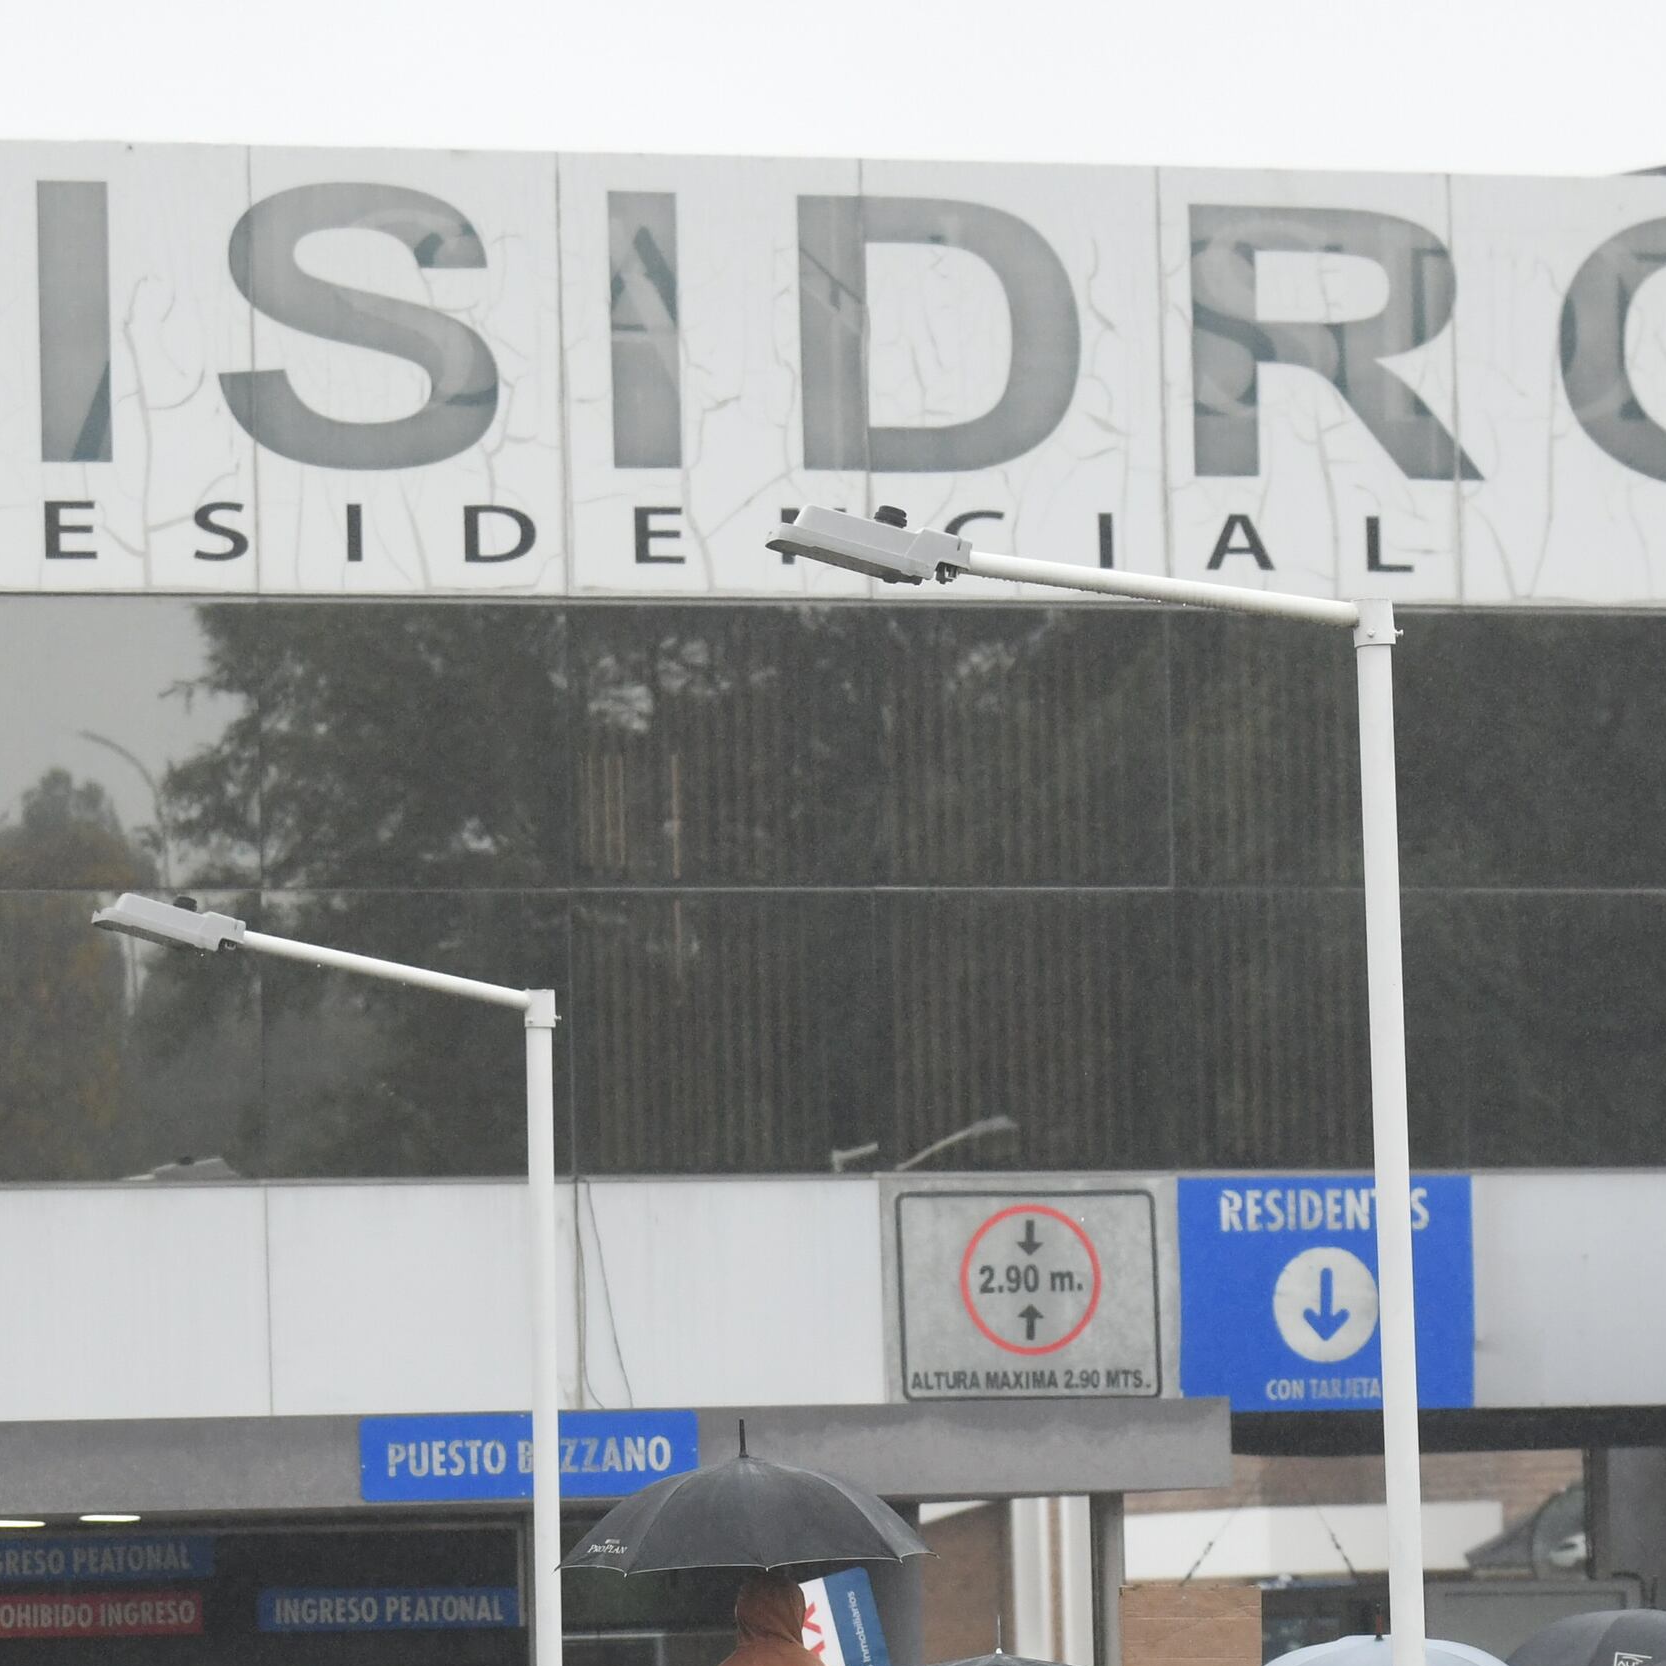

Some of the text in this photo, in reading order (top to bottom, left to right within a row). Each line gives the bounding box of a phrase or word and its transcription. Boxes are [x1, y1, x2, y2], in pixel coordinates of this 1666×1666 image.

[1220, 1187, 1431, 1234] RESIDENS
[978, 1263, 1085, 1295] 2.90 m.
[910, 1370, 981, 1391] ALTURA
[1063, 1368, 1102, 1390] 2.90
[1105, 1367, 1152, 1389] MTS.
[1265, 1378, 1304, 1400] CON
[386, 1437, 672, 1478] PUESTO BZZANO
[72, 1541, 191, 1576] PEATONAL
[99, 1598, 197, 1628] INGRESO
[273, 1594, 505, 1626] INGRESO PEATONAL
